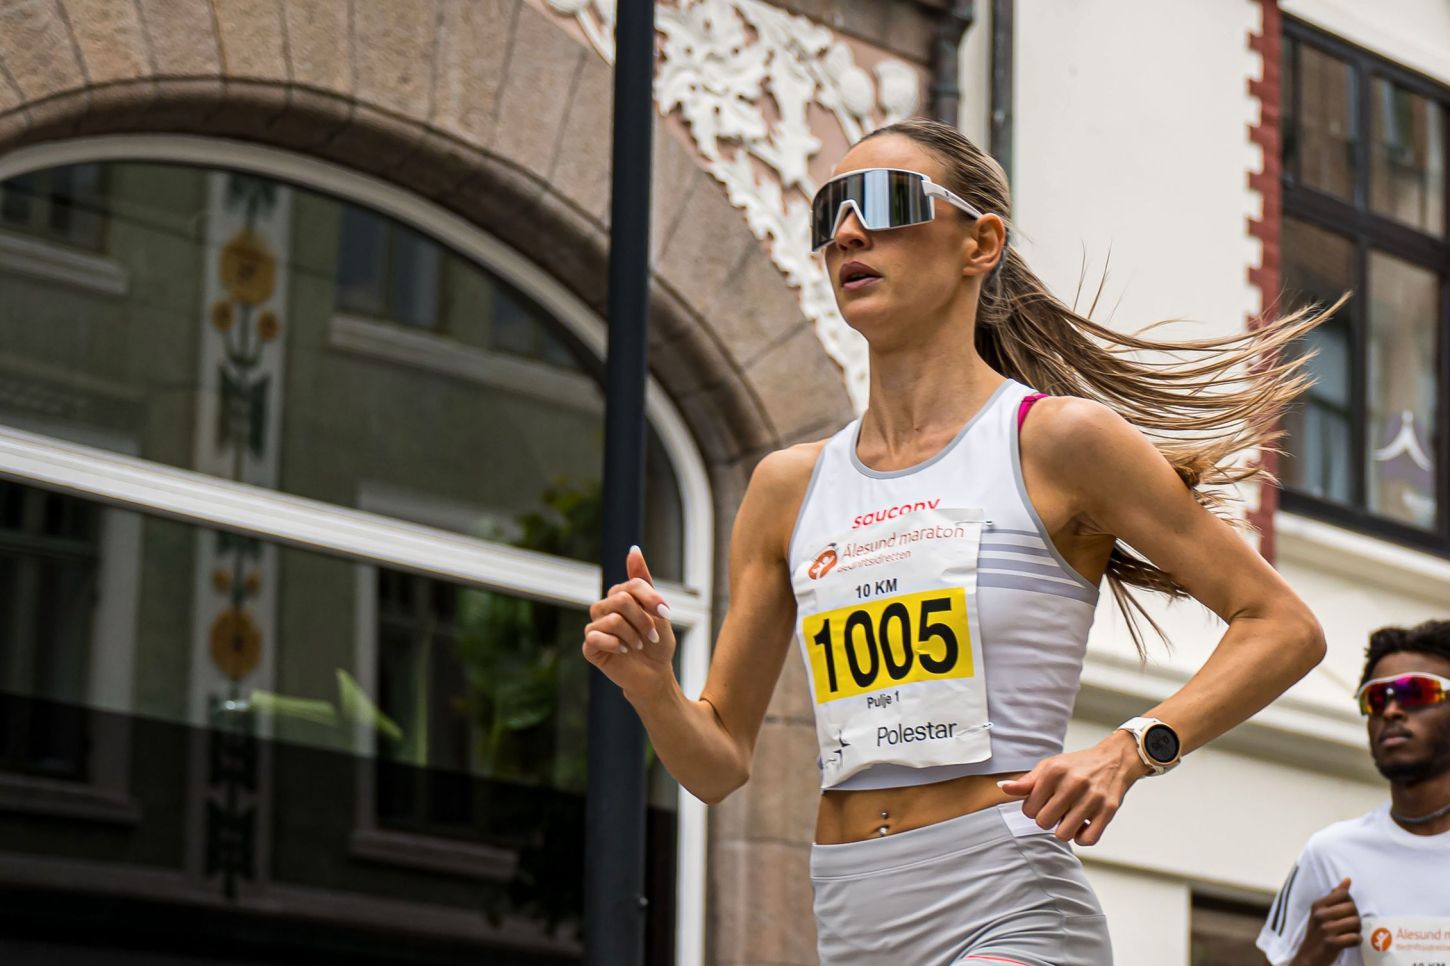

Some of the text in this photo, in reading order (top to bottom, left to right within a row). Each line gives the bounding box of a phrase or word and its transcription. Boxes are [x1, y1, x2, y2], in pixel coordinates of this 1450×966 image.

[899, 525, 965, 545] maraton
[856, 578, 898, 599] 10 KM
[814, 597, 959, 693] 1005
[867, 690, 899, 709] Pulje 1
[877, 722, 957, 747] Polestar
